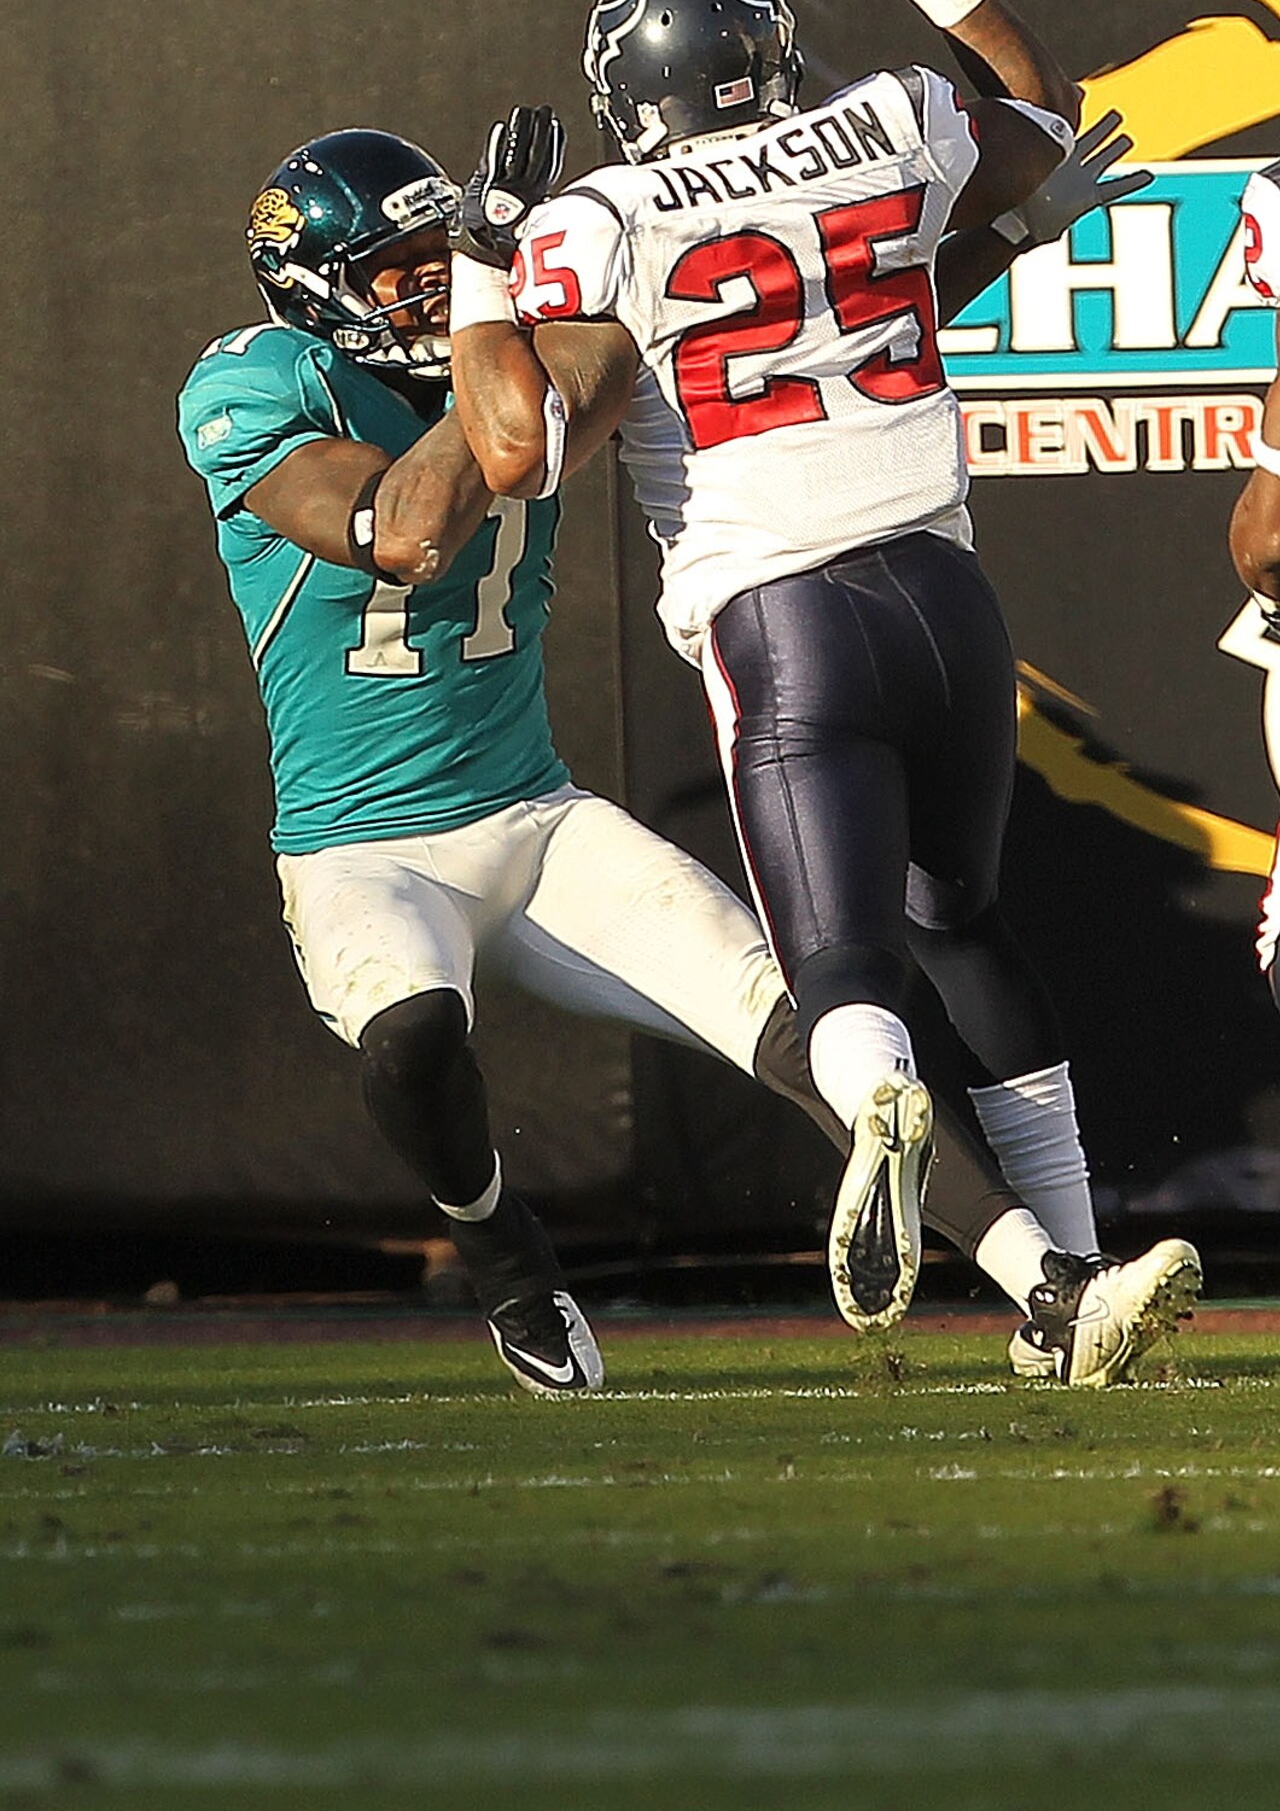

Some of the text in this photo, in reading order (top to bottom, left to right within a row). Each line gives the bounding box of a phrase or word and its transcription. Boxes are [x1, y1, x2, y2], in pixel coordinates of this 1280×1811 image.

[651, 101, 897, 213] JACKSON
[509, 230, 581, 320] 5
[666, 184, 948, 451] 25
